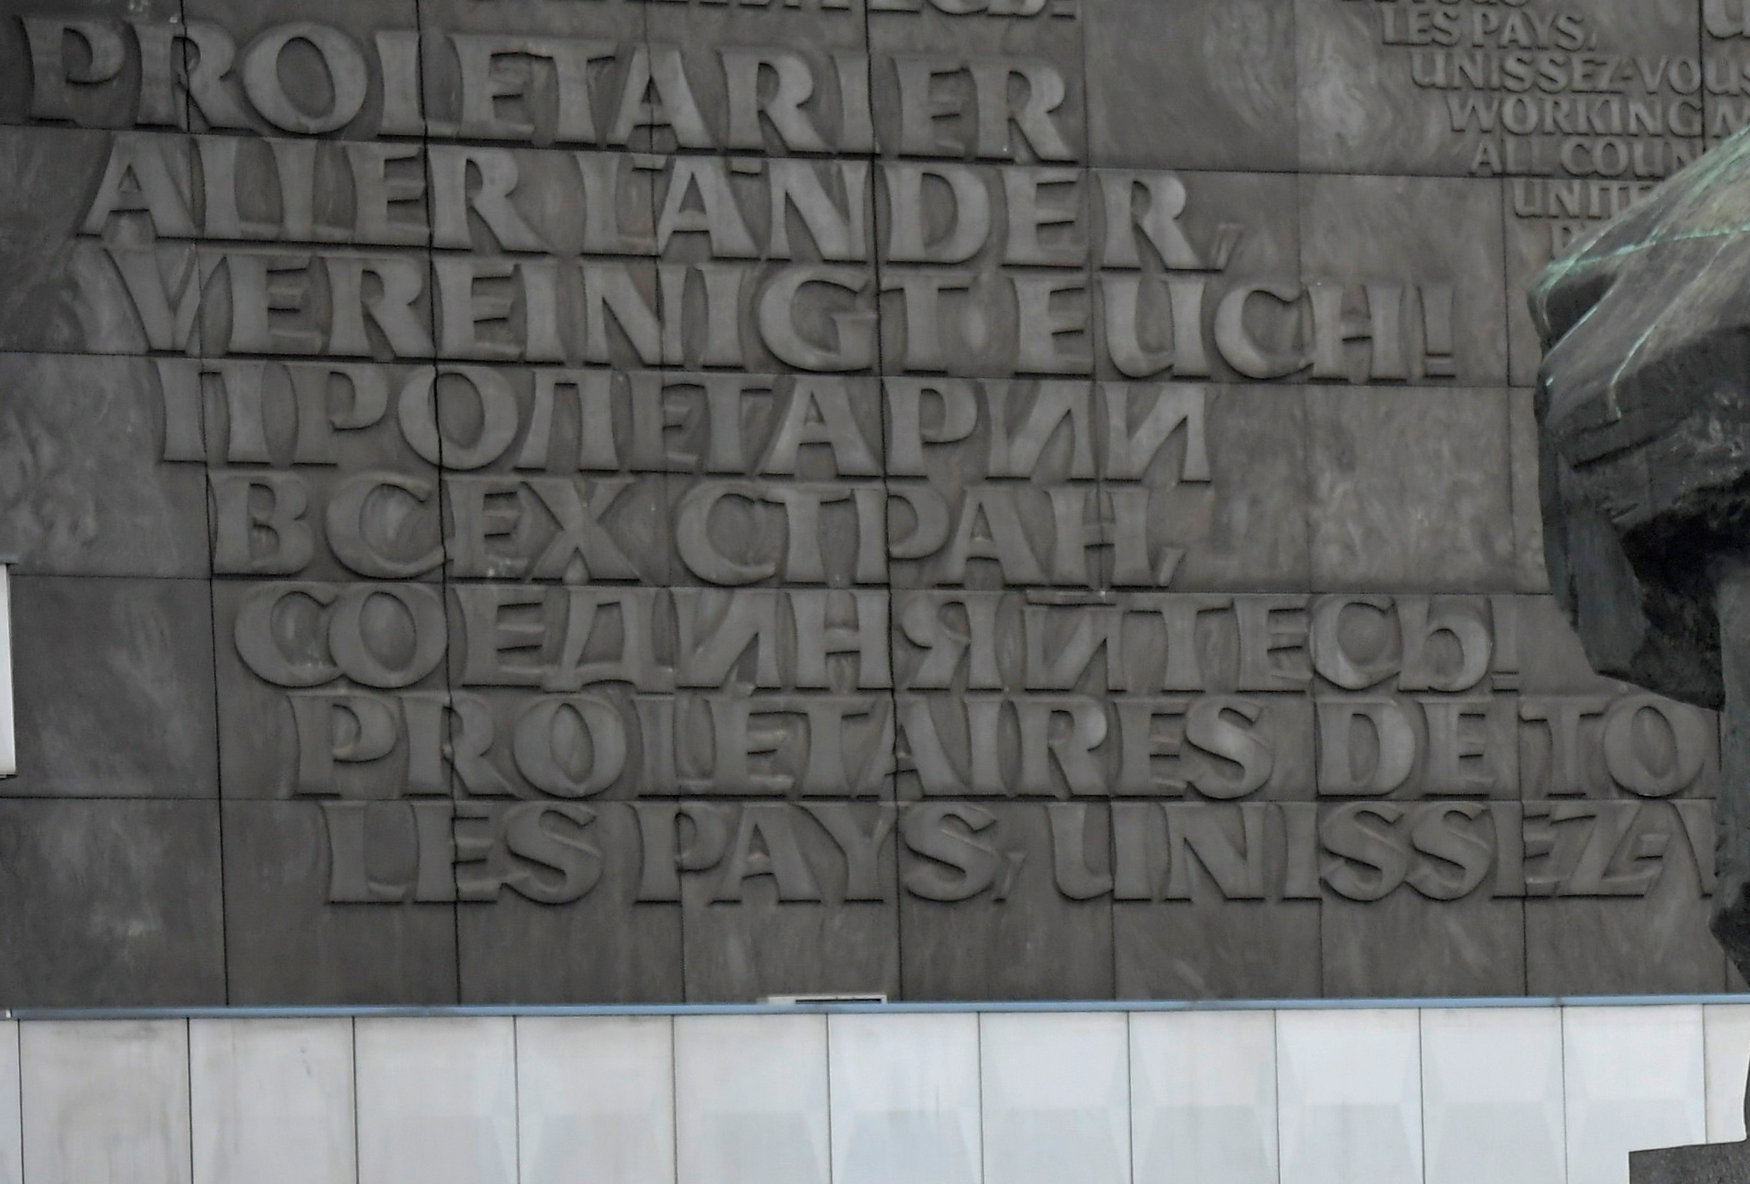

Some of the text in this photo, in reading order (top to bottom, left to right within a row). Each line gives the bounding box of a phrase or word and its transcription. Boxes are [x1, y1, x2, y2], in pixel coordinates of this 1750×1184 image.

[1381, 8, 1464, 46] LES
[18, 15, 1078, 164] PROLETARIER
[1447, 92, 1703, 138] WORKING
[77, 133, 557, 253] ALLER
[1470, 137, 1552, 176] ALL
[103, 243, 1457, 385] VEREINIGT EUCH!
[155, 357, 1211, 482] ПРОЛЕТАРИИ
[212, 468, 1186, 589] ВСЕХ СТРАН,
[288, 690, 1706, 799] PROLETAIRES DE TO
[320, 801, 602, 905] LES
